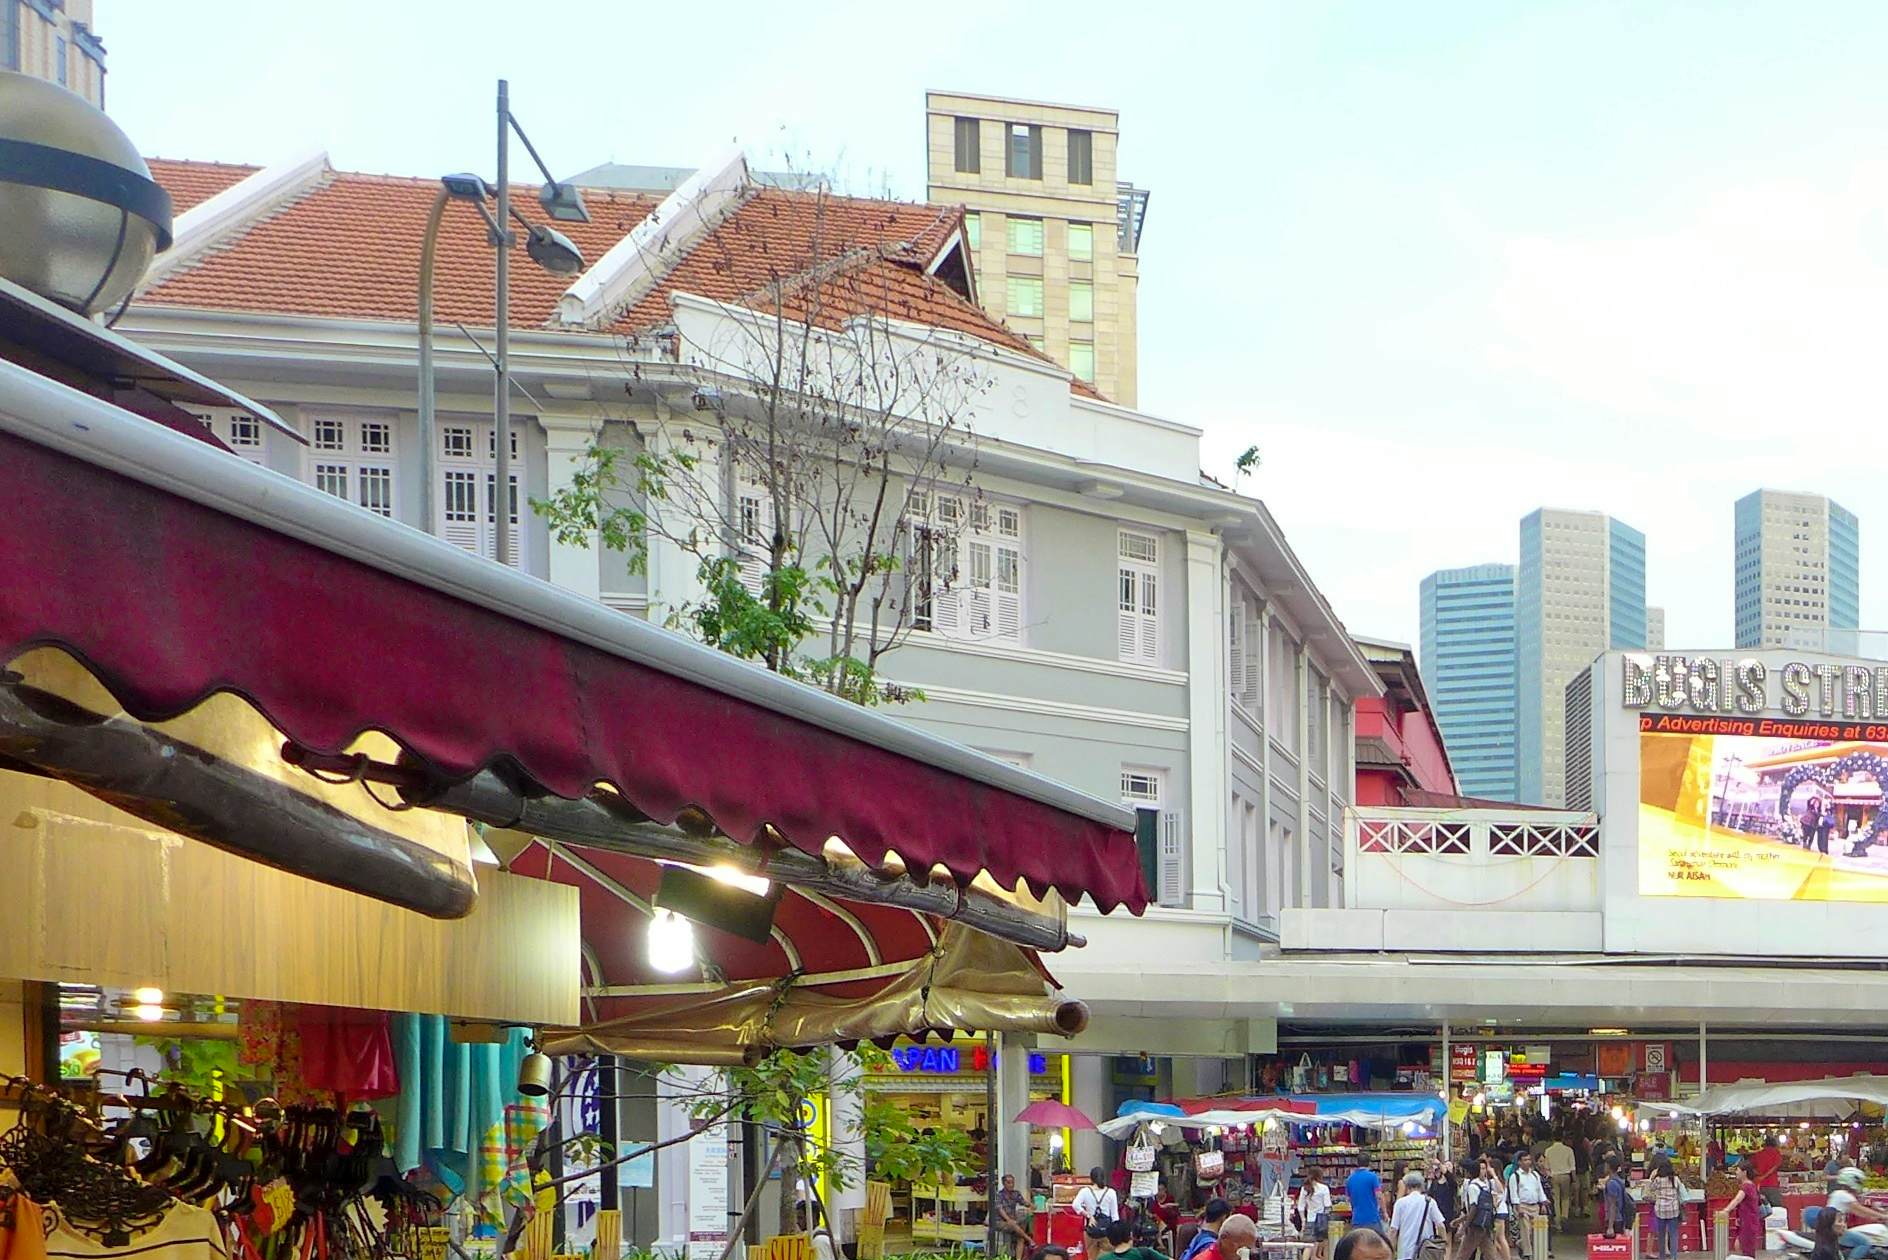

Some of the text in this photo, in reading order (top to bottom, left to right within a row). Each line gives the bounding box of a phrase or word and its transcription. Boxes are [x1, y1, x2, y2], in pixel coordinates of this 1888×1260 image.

[1622, 653, 1766, 713] BUGIS
[1658, 715, 1754, 736] Advertising
[1759, 720, 1839, 737] Enquiries
[1844, 727, 1860, 739] at
